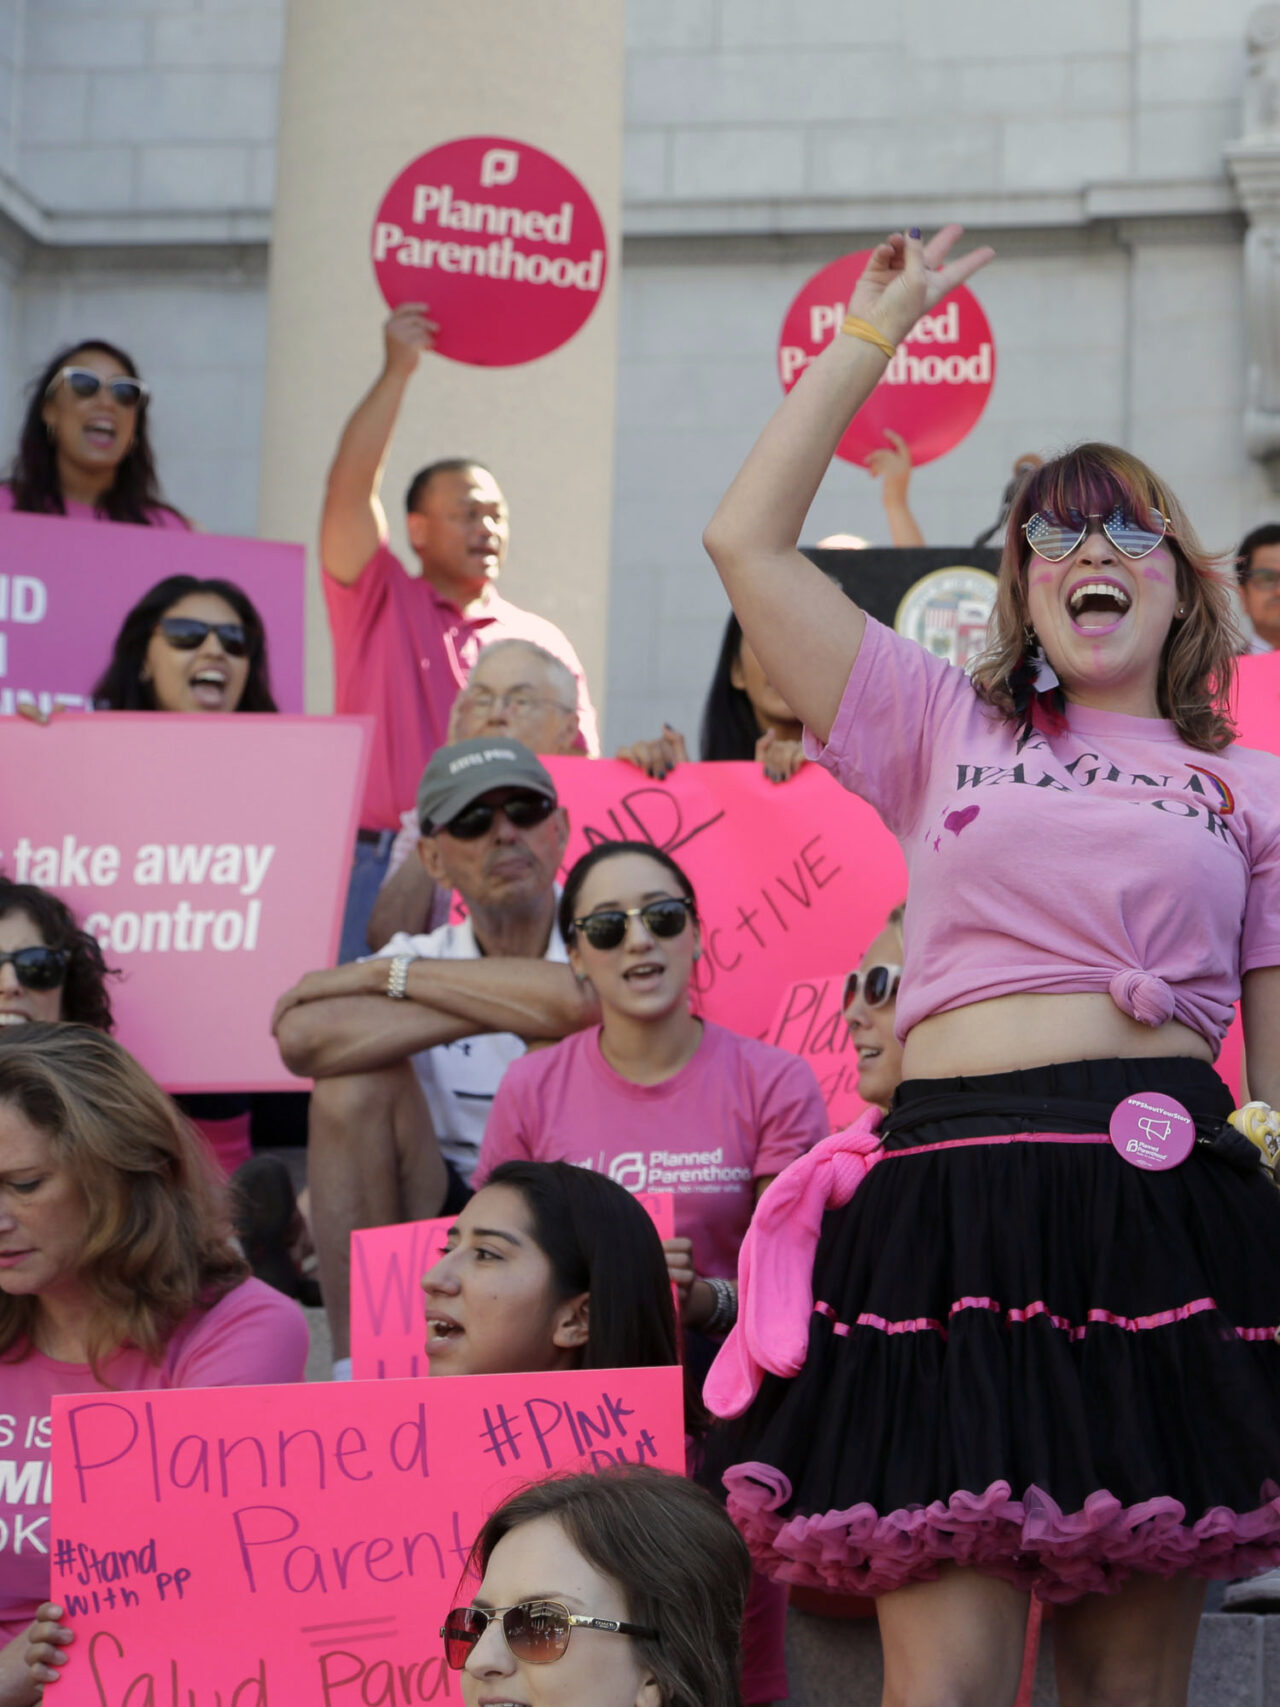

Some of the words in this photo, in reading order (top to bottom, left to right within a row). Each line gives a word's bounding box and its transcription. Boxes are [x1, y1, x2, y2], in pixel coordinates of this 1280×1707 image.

[412, 184, 573, 245] Planned
[375, 223, 603, 291] Parenthood
[810, 302, 959, 343] Pled
[781, 343, 992, 385] Pthood
[14, 835, 120, 887] take
[134, 844, 275, 895] away
[83, 900, 262, 953] control
[649, 1147, 723, 1168] Planned
[24, 1416, 52, 1449] IS
[68, 1402, 430, 1502] Planned
[54, 1539, 157, 1586] #Stand
